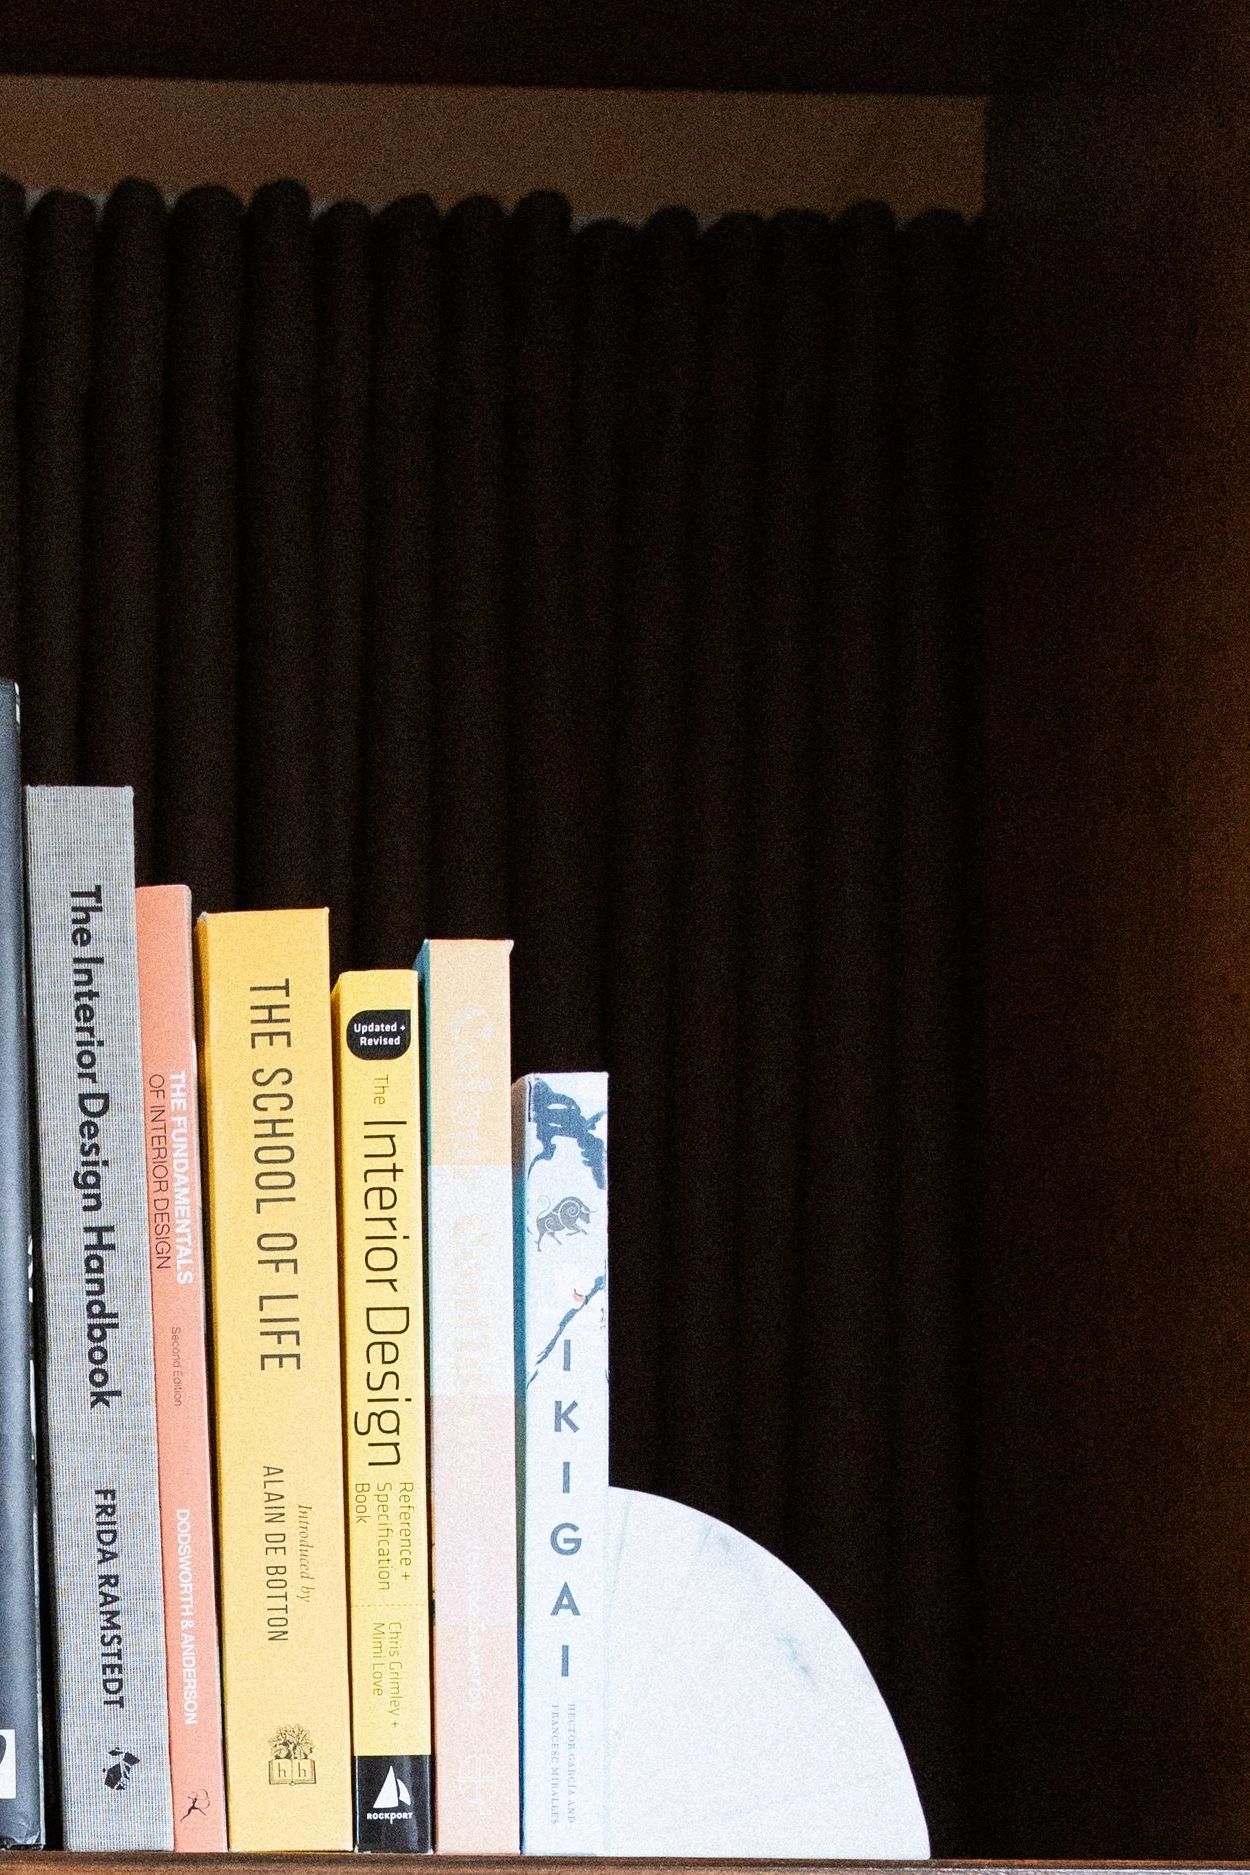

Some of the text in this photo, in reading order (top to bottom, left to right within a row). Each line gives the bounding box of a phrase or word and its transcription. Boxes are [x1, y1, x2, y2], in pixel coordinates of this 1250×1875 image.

[353, 1022, 398, 1034] Updated
[359, 1035, 401, 1047] Revised
[69, 884, 123, 1409] The Interior Design Handbook
[148, 1073, 171, 1270] OF INTERIOR DESIGN
[169, 1071, 195, 1285] THE FUNDAMENTALS
[250, 977, 302, 1371] THE SCHOOL OF LIFE
[354, 1073, 412, 1467] The Interior Design
[170, 1326, 183, 1368] Second
[262, 1465, 289, 1642] ALAIN DE BOTTON
[296, 1503, 316, 1603] Introduced by
[355, 1482, 371, 1524] Book
[374, 1482, 393, 1591] Specification
[398, 1482, 414, 1566] Reference
[94, 1488, 125, 1709] FRIDA RAMSTEDT
[175, 1508, 199, 1726] DODSWORTH & ANDERSON
[388, 1621, 403, 1657] Chris
[371, 1622, 385, 1697] Mimi Love
[387, 1661, 403, 1717] Grimley
[550, 1704, 561, 1826] FRANCESC MIRALLES
[567, 1798, 577, 1824] AND
